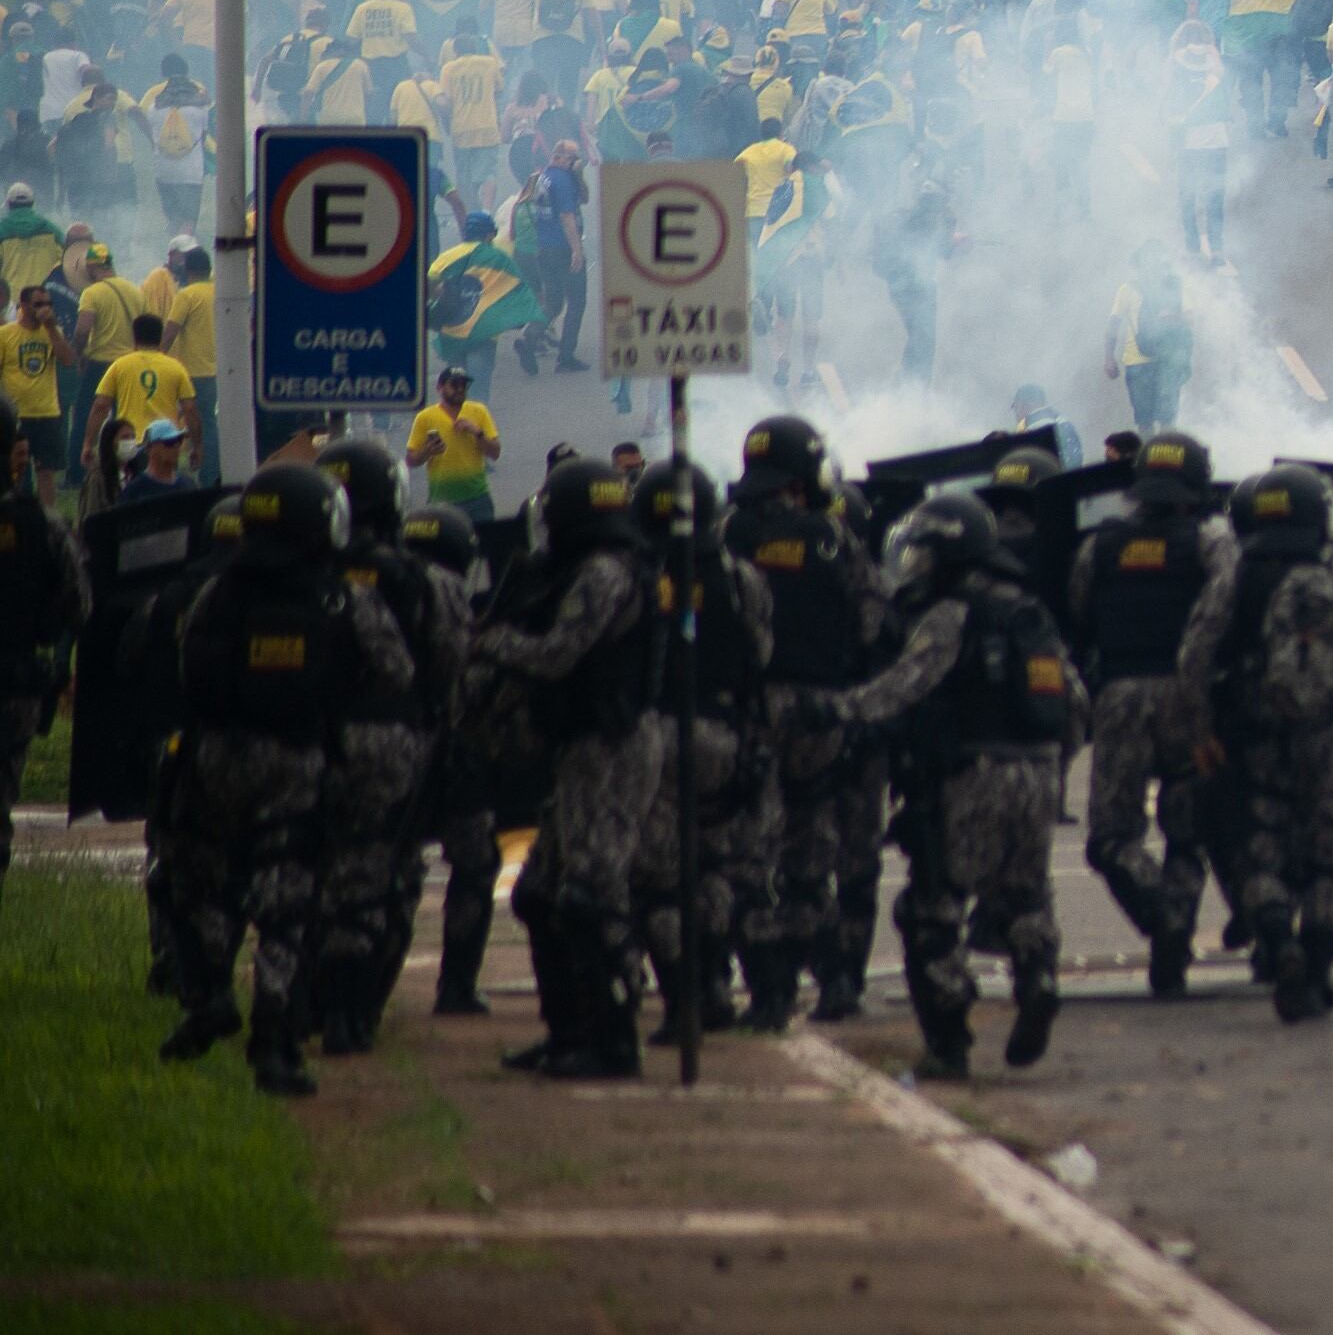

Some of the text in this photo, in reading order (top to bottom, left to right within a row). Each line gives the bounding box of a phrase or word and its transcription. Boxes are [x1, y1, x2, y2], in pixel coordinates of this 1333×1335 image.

[311, 183, 368, 258] E
[655, 204, 699, 263] E
[636, 298, 717, 335] TÁXI
[294, 328, 387, 350] CARGA
[331, 352, 349, 375] E
[140, 369, 158, 400] 9
[268, 375, 411, 398] DESCARGA
